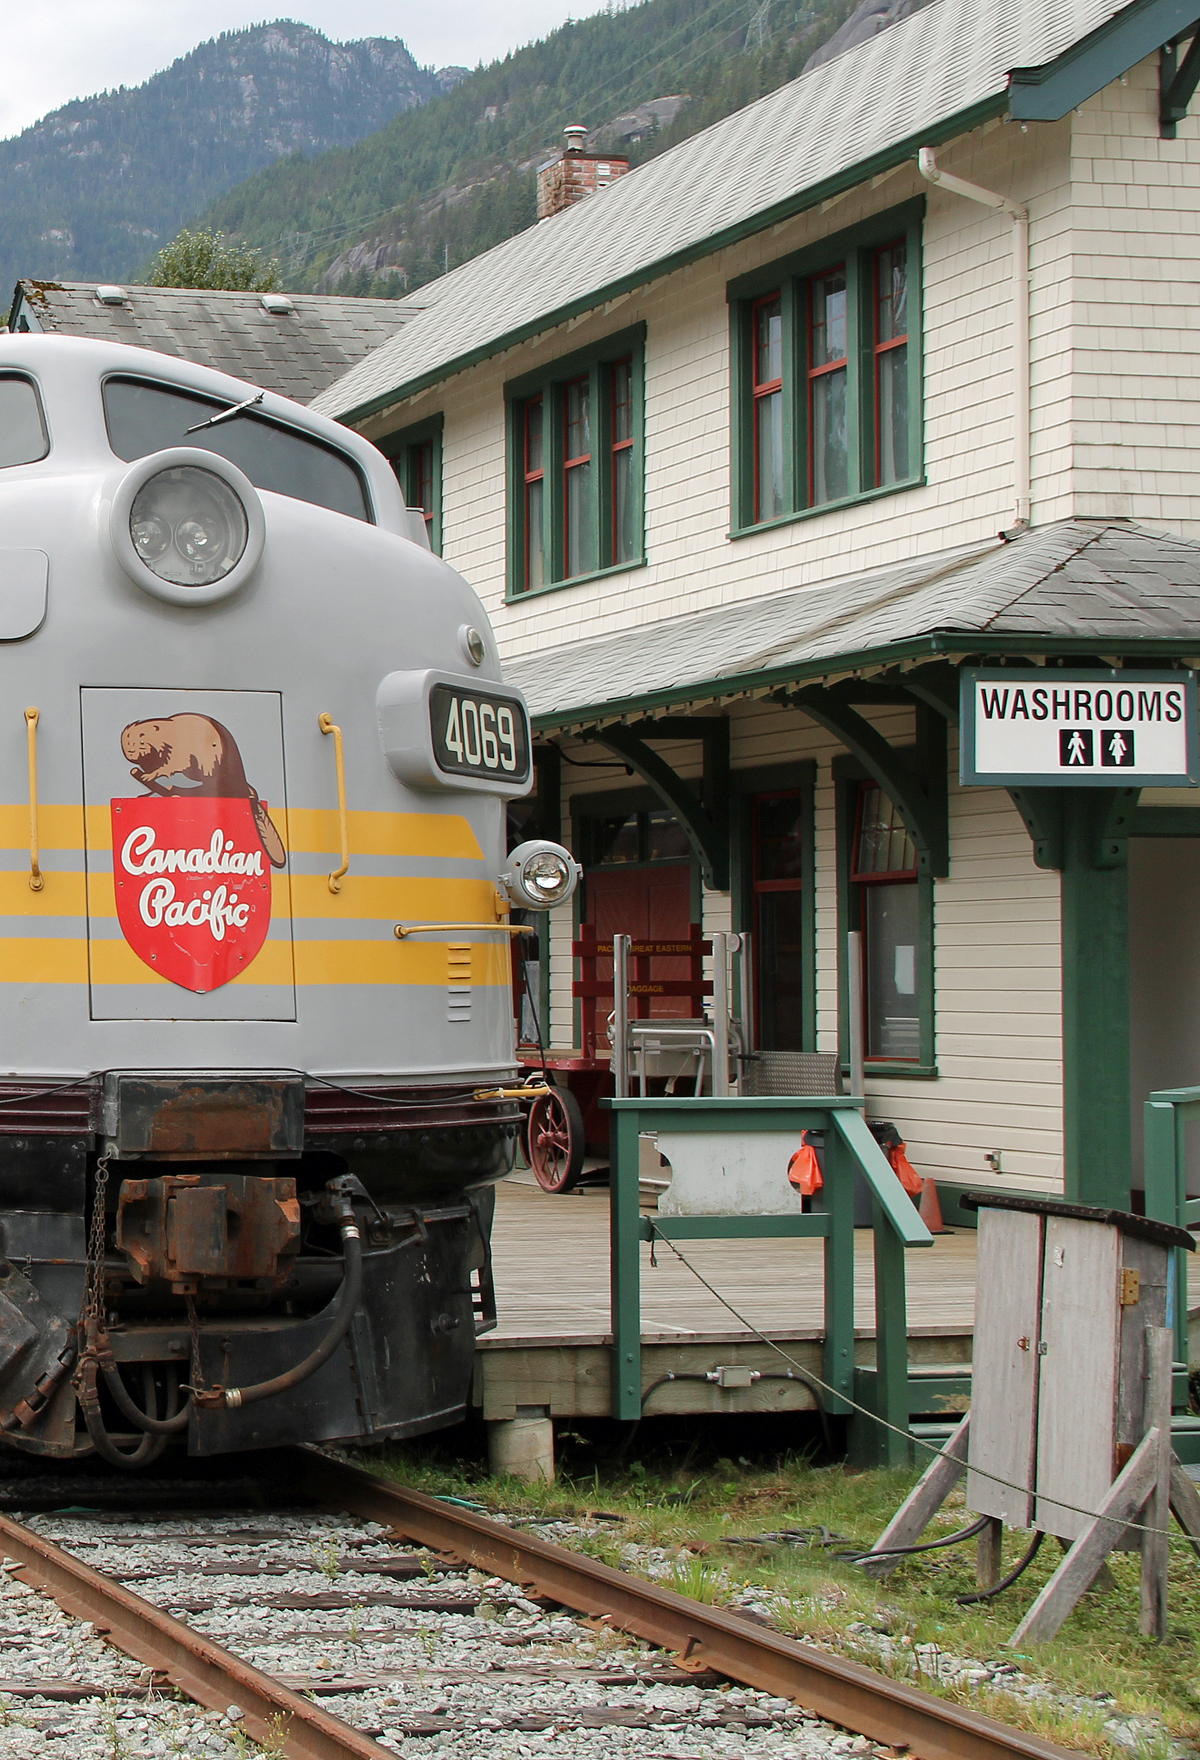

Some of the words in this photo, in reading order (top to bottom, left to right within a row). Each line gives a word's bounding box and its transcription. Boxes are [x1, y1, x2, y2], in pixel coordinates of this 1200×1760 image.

[980, 688, 1182, 722] WASHROOMS
[445, 697, 516, 771] 4069
[121, 826, 264, 877] Canadian
[139, 877, 250, 941] Pacific
[656, 944, 692, 952] EASTERN
